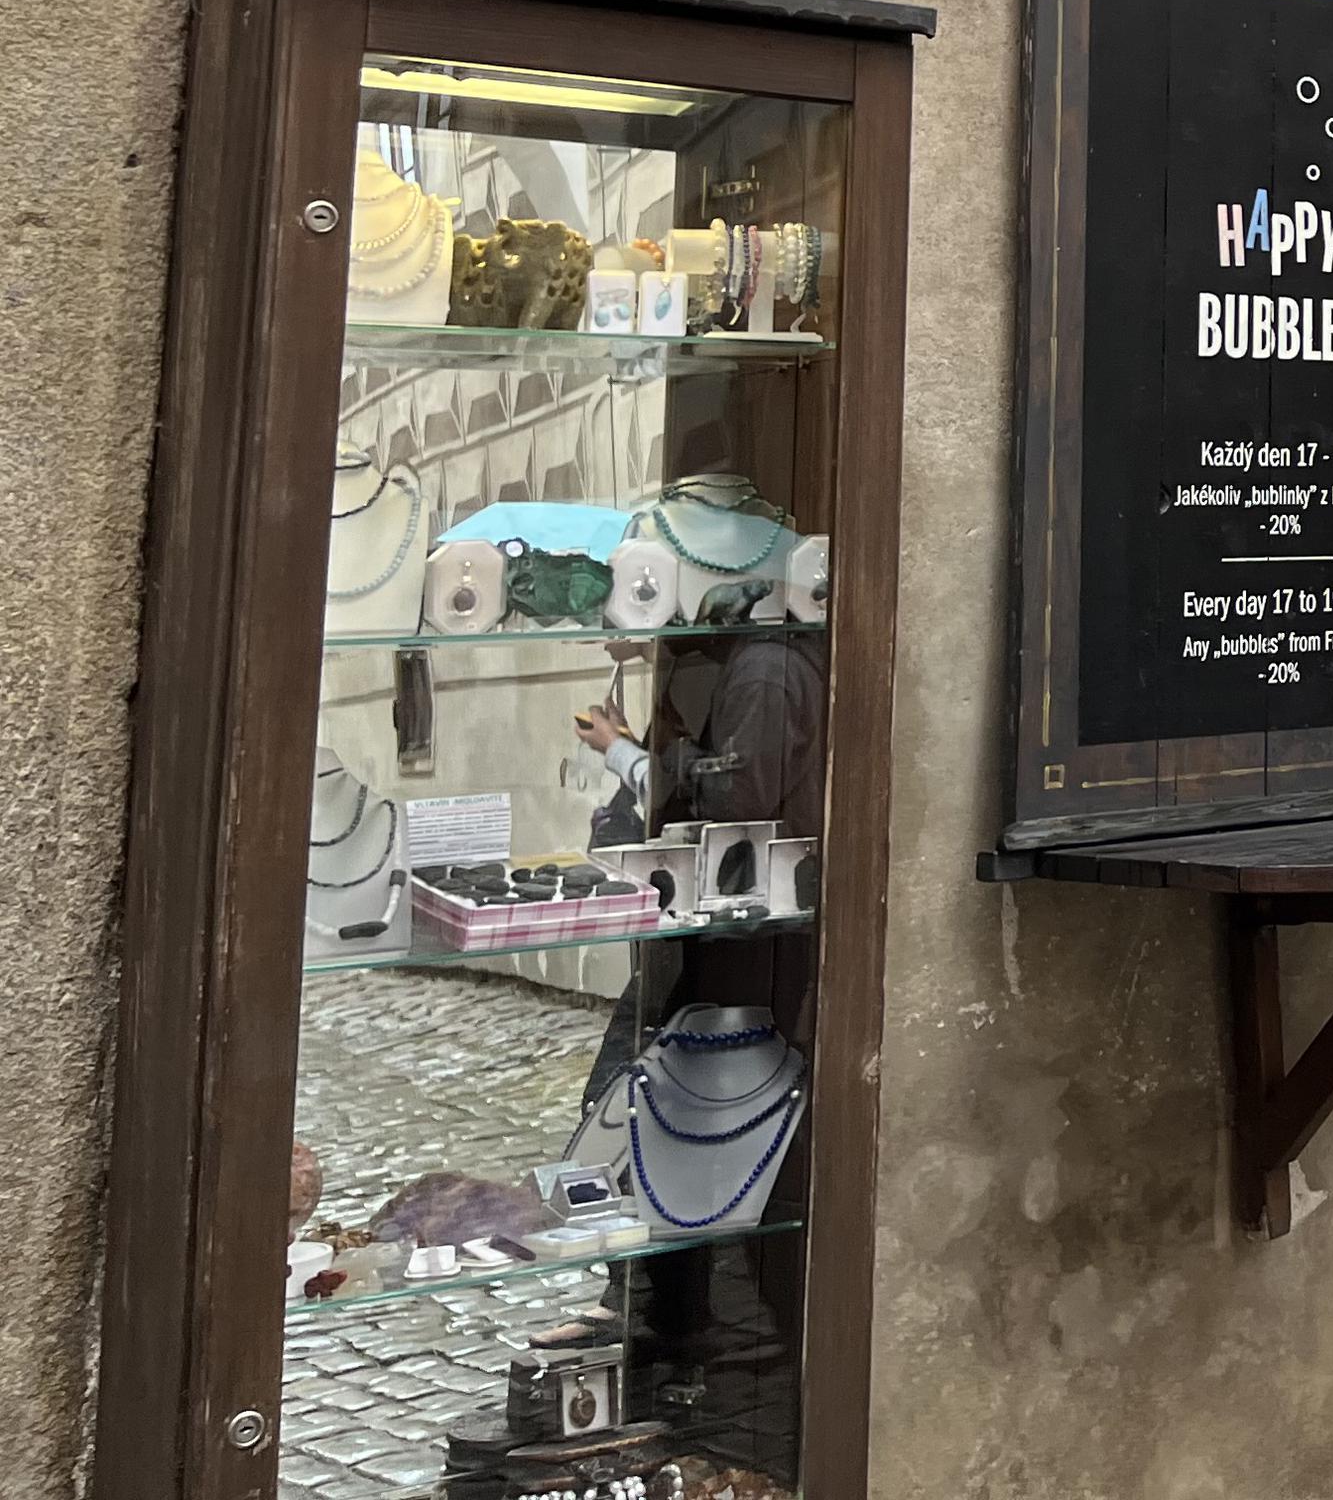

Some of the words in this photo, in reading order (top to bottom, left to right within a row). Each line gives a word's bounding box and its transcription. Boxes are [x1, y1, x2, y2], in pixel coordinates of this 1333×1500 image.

[1201, 441, 1253, 472] Každý
[1258, 442, 1291, 467] den
[1297, 442, 1318, 467] 17
[1173, 484, 1241, 506] Jakékoliv
[1320, 489, 1328, 505] z
[1269, 514, 1302, 535] 20%
[1183, 591, 1231, 622] Every
[1235, 590, 1267, 621] day
[1272, 589, 1294, 614] 17
[1299, 589, 1317, 613] to
[1182, 636, 1210, 662] Any
[1288, 631, 1322, 652] from
[1268, 661, 1301, 684] 20%
